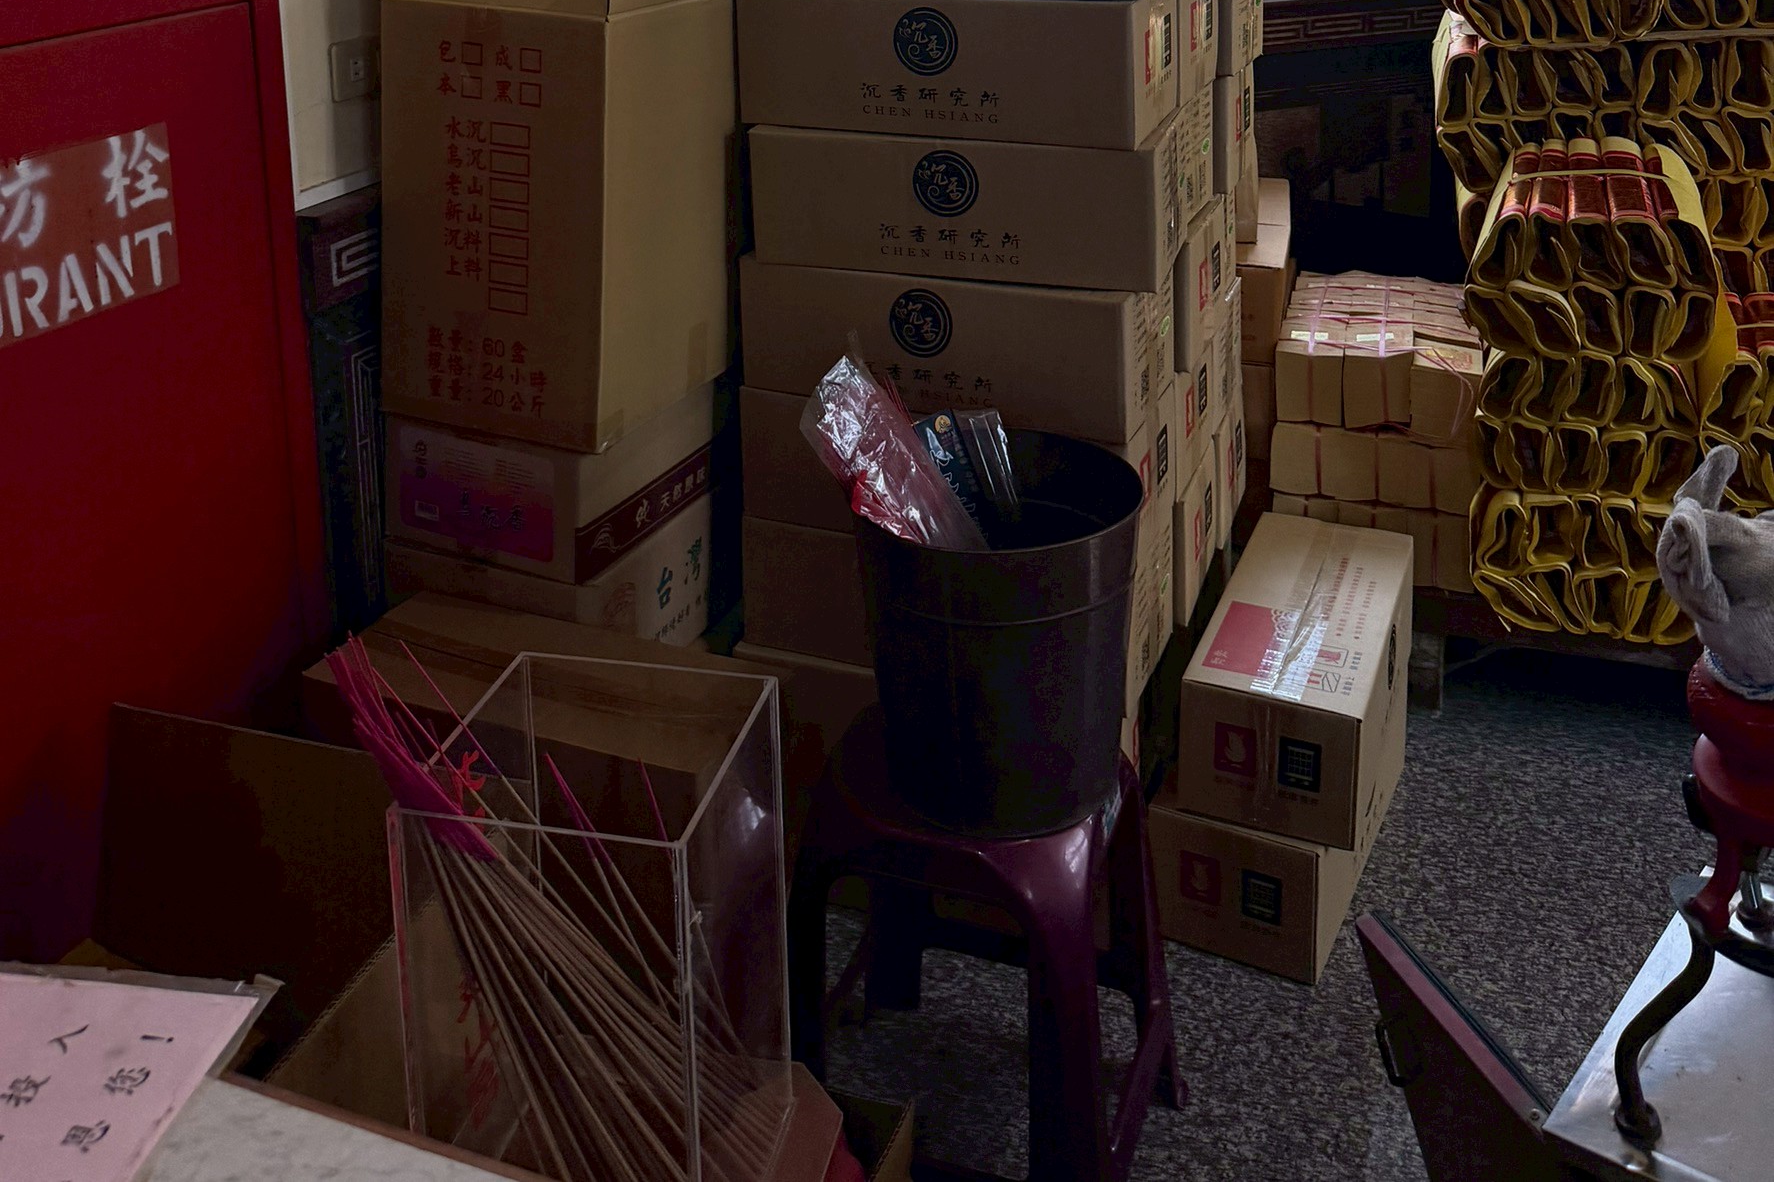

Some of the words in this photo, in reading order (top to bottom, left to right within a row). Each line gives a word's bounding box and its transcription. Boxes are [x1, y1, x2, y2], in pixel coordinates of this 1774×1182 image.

[861, 83, 1000, 107] 沉香研究所
[863, 104, 912, 117] CHEN
[924, 109, 999, 124] HSIANG
[445, 116, 487, 143] 水沉
[445, 199, 483, 224] 新山
[879, 223, 1022, 249] 沉香研究所
[880, 245, 930, 258] CHEN
[944, 250, 1020, 265] HSIANG
[0, 222, 173, 338] RANT
